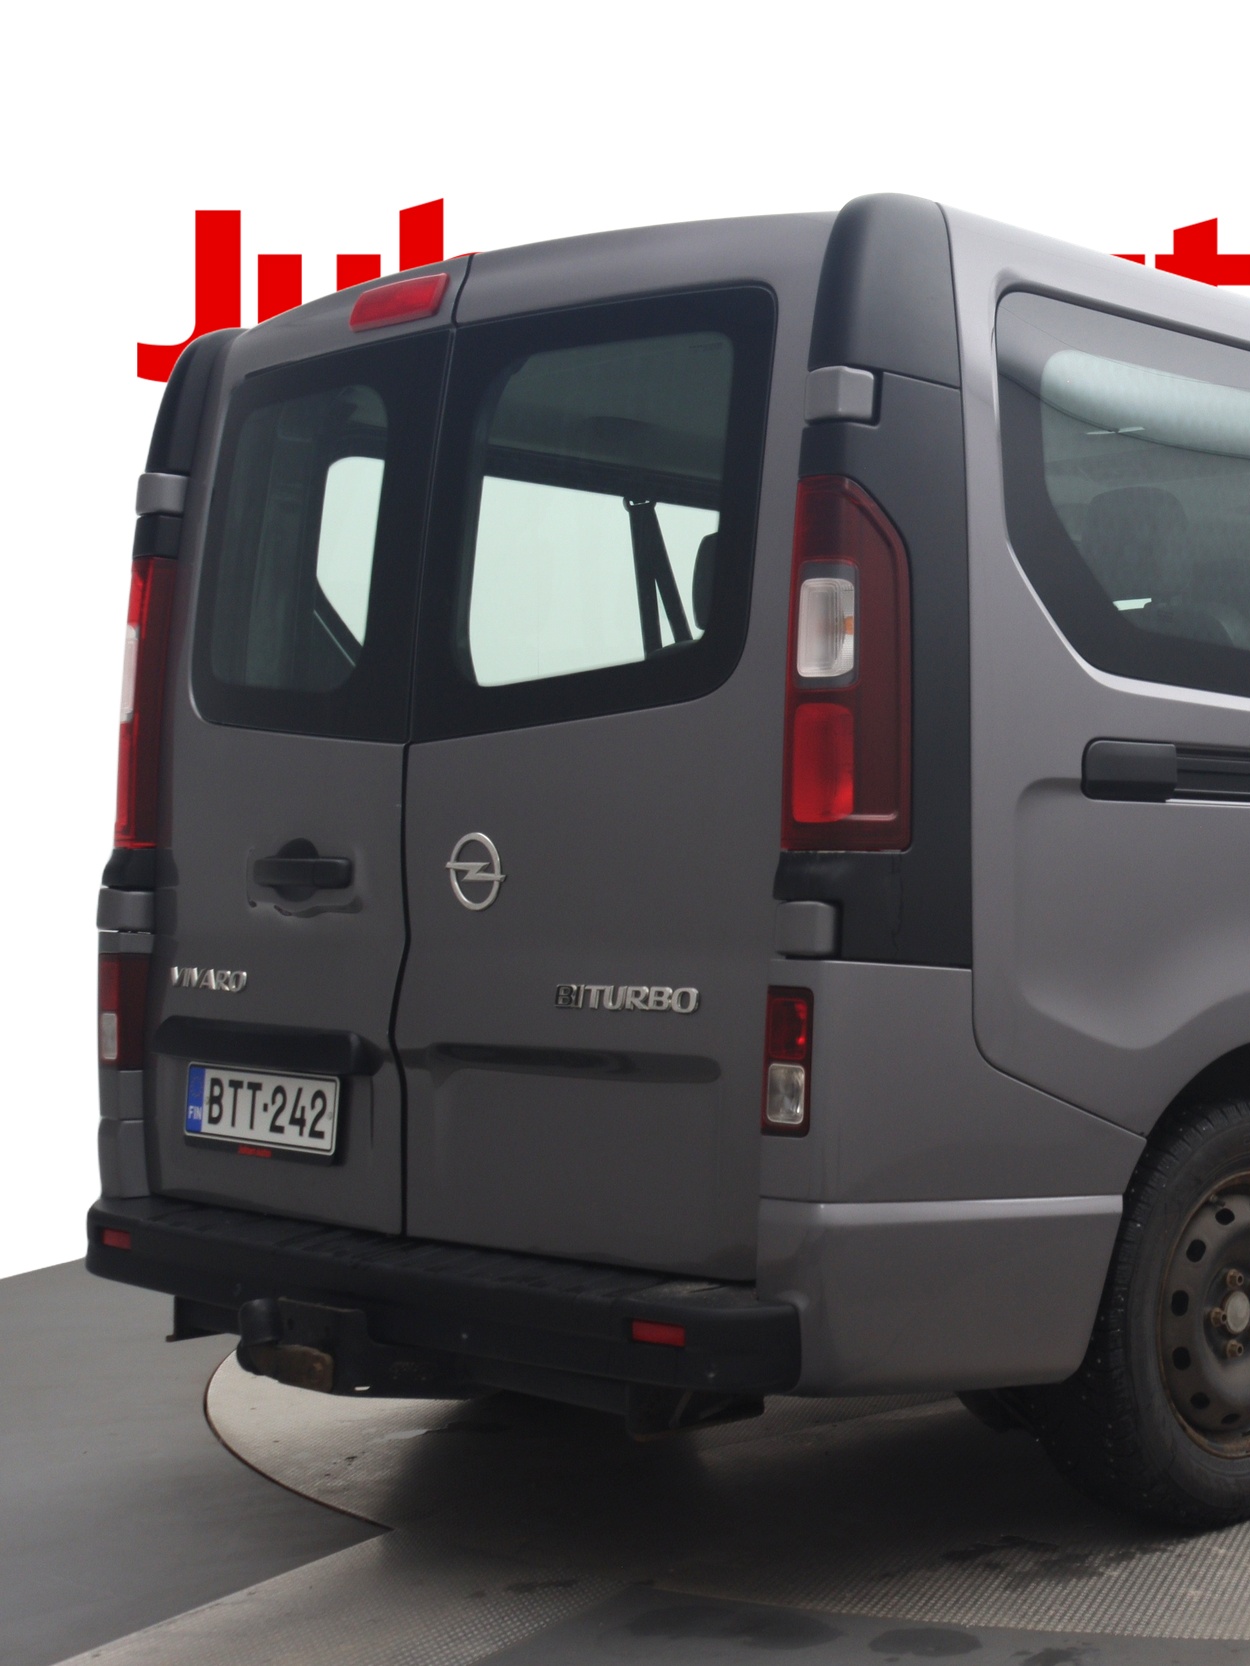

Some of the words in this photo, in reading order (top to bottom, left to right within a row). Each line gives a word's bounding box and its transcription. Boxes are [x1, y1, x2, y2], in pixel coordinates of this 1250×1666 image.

[170, 966, 247, 992] VIVARO
[555, 984, 699, 1014] BITURBO
[207, 1077, 328, 1140] BTT-242
